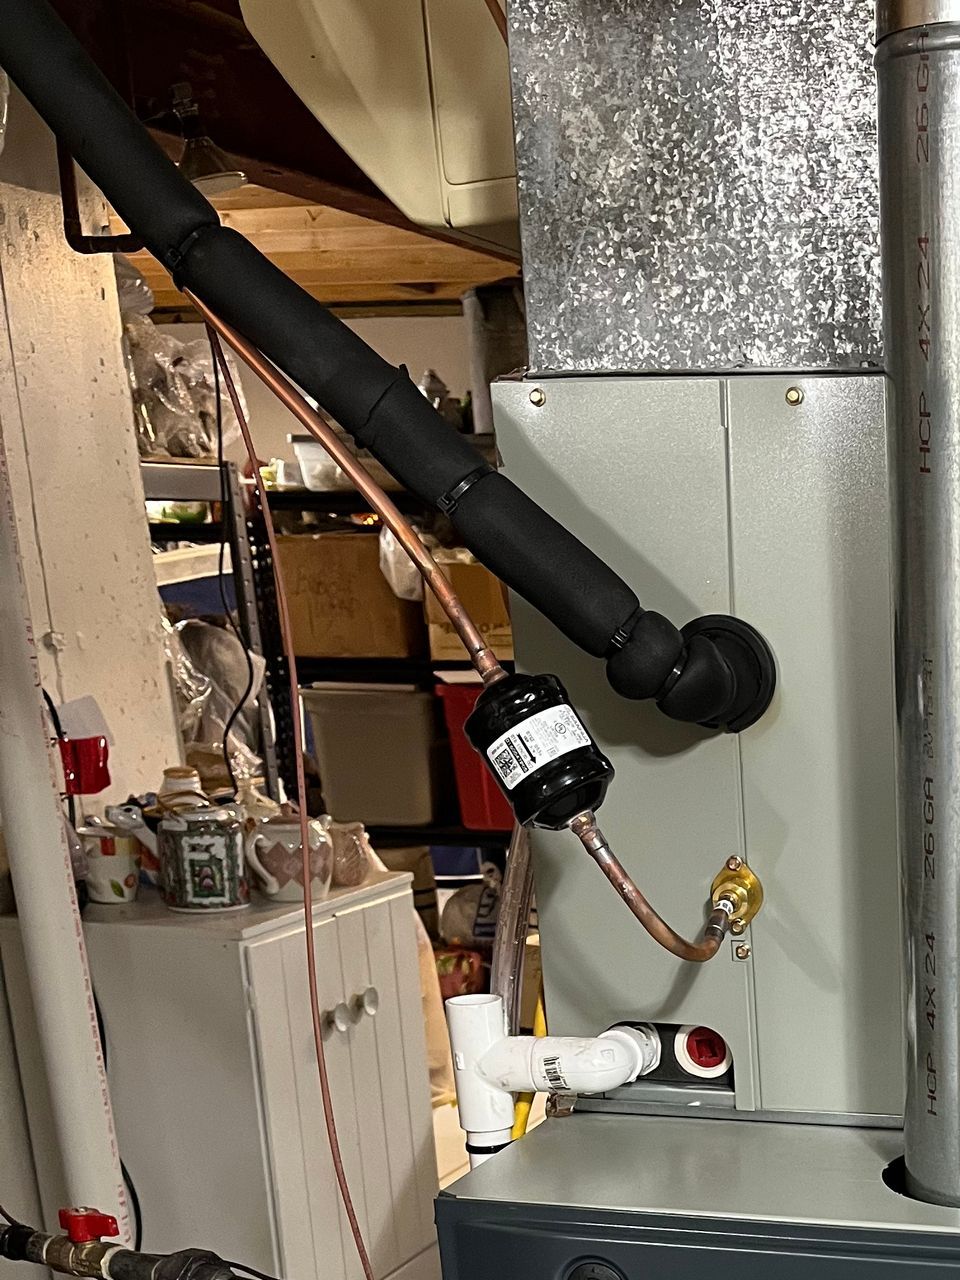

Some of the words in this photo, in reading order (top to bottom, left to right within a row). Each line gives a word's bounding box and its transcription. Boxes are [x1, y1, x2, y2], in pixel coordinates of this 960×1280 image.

[916, 103, 930, 164] 26
[918, 392, 931, 474] HCP
[923, 777, 934, 825] GA
[924, 832, 935, 879] 26
[926, 1052, 938, 1116] HCP
